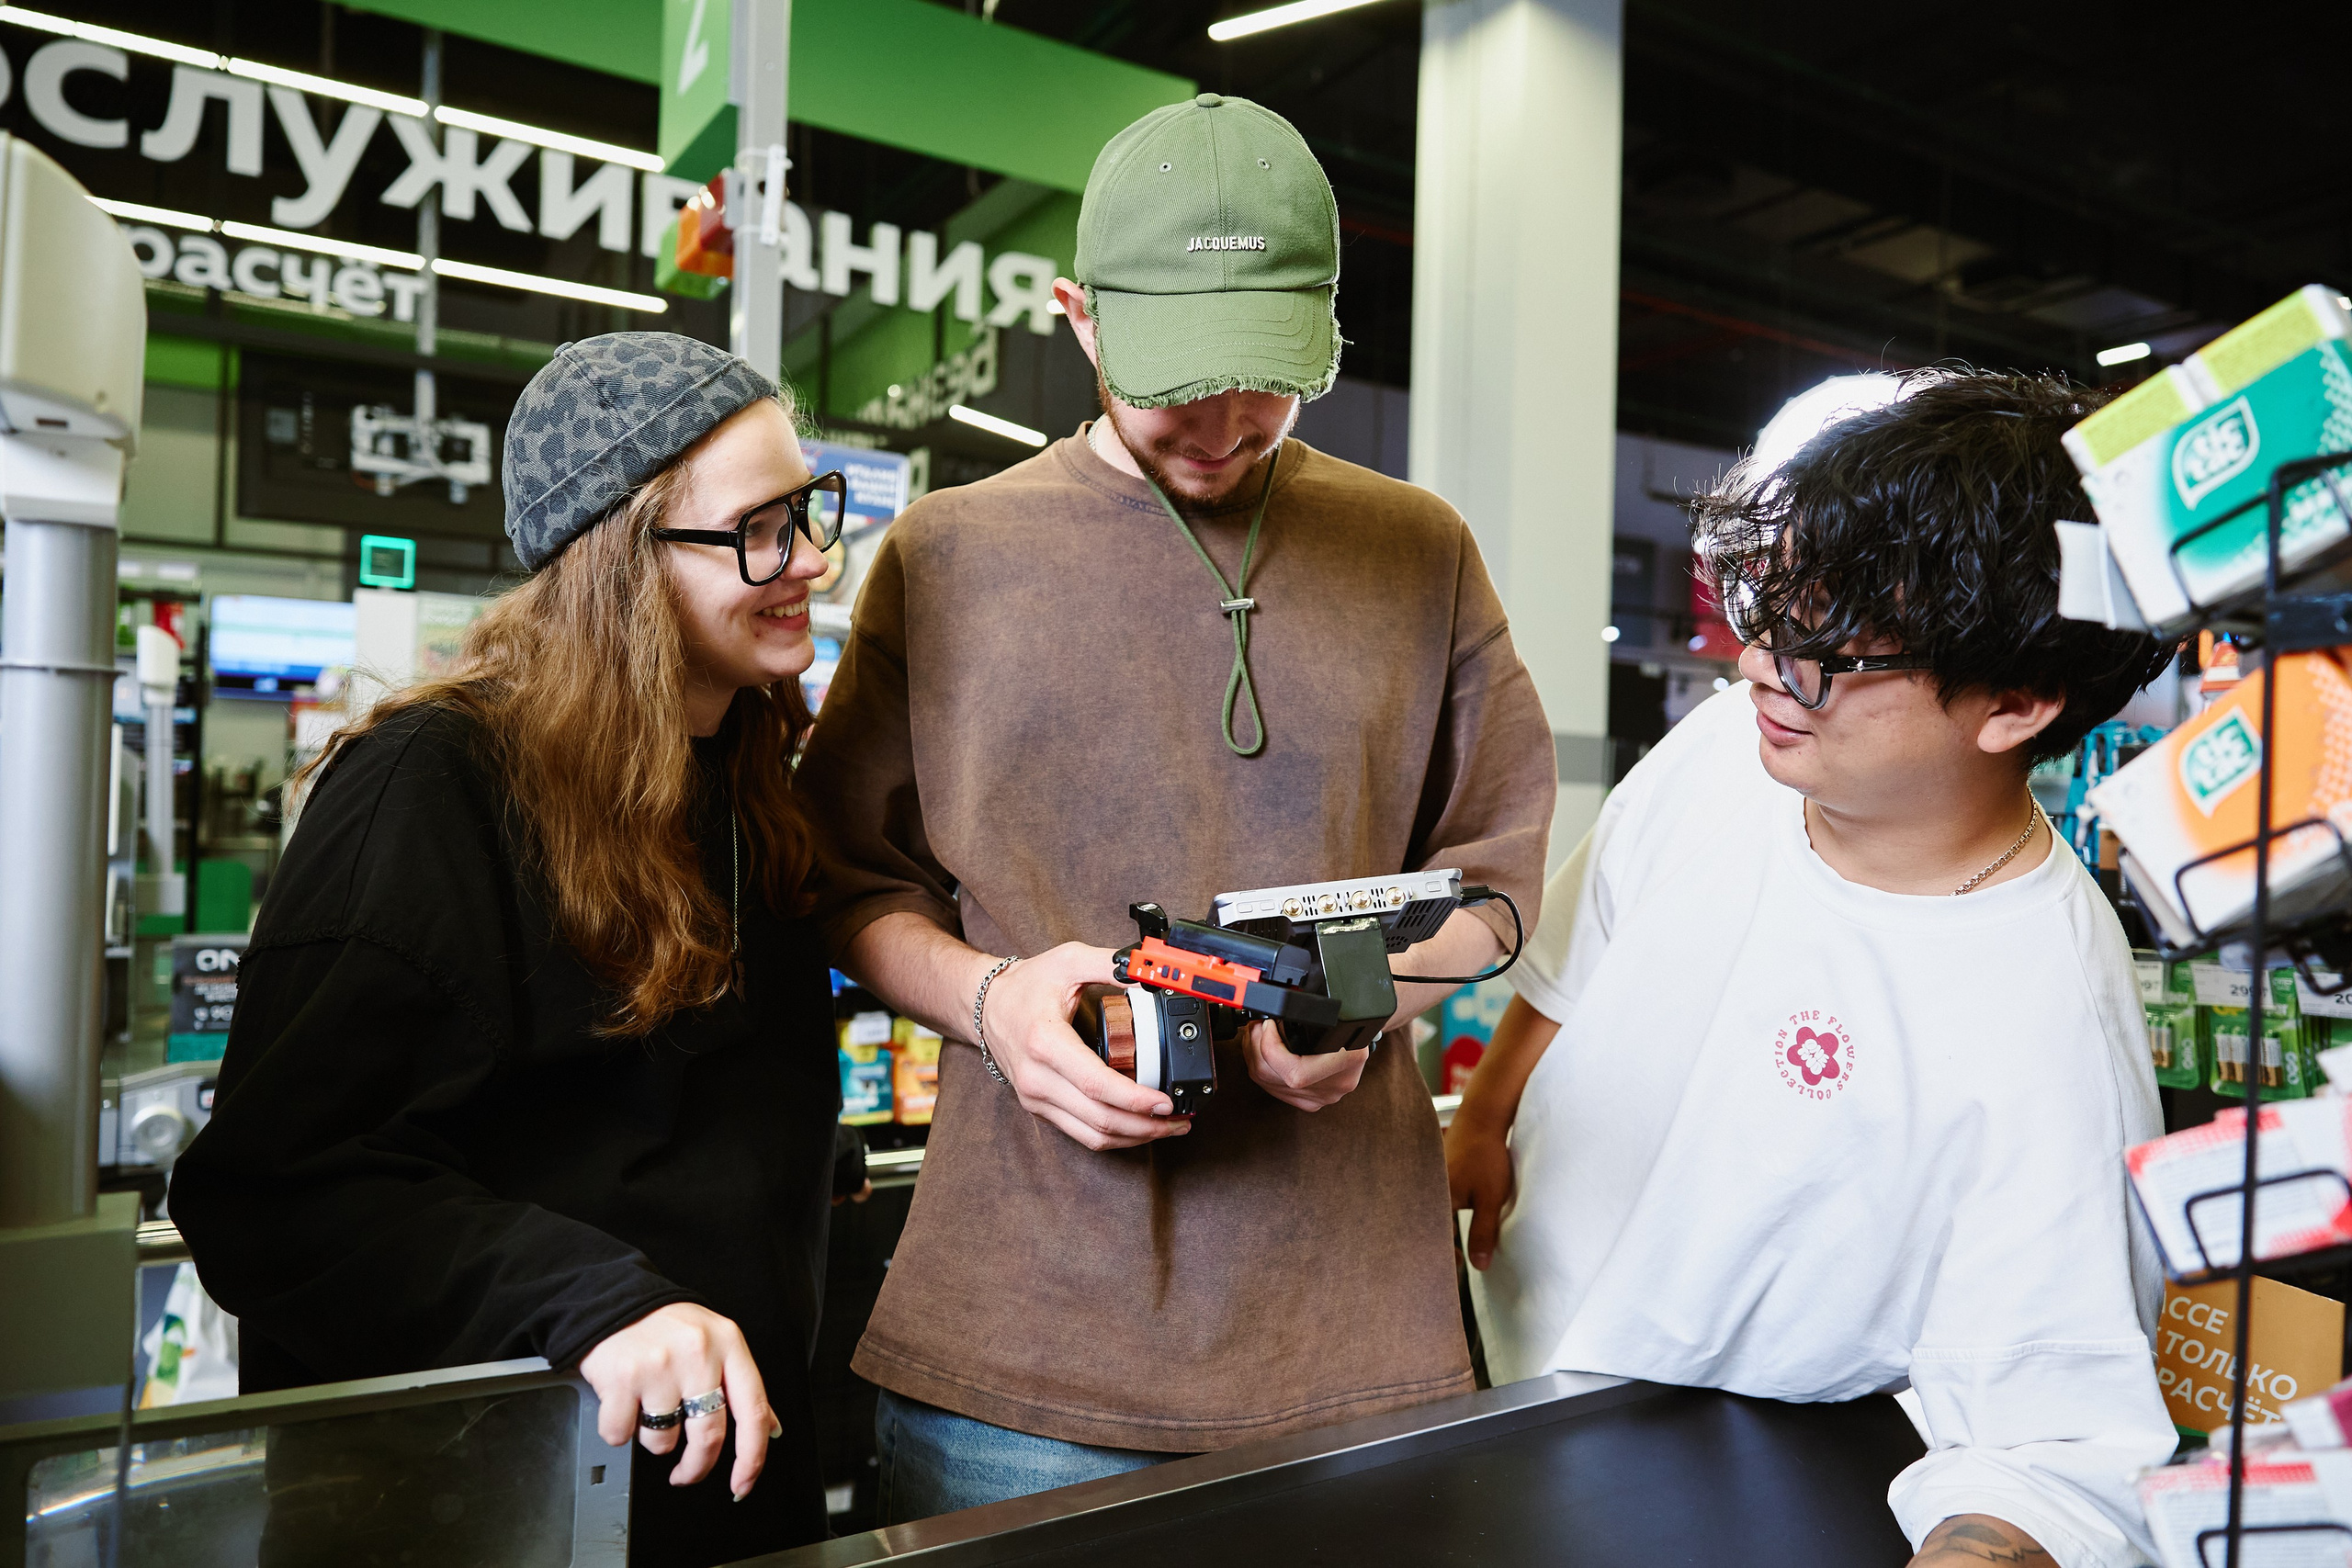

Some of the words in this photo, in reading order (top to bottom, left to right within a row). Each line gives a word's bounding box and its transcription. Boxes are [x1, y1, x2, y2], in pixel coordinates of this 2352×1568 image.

[0, 39, 1057, 336] служиания
[1186, 236, 1266, 252] JACQUEMUS
[2230, 984, 2254, 997] 29
[1789, 1010, 1820, 1025] THE
[1774, 1029, 1832, 1100] COLLECTION
[1827, 1016, 1855, 1091] FLOWERS
[2162, 1296, 2229, 1335] ССЕ
